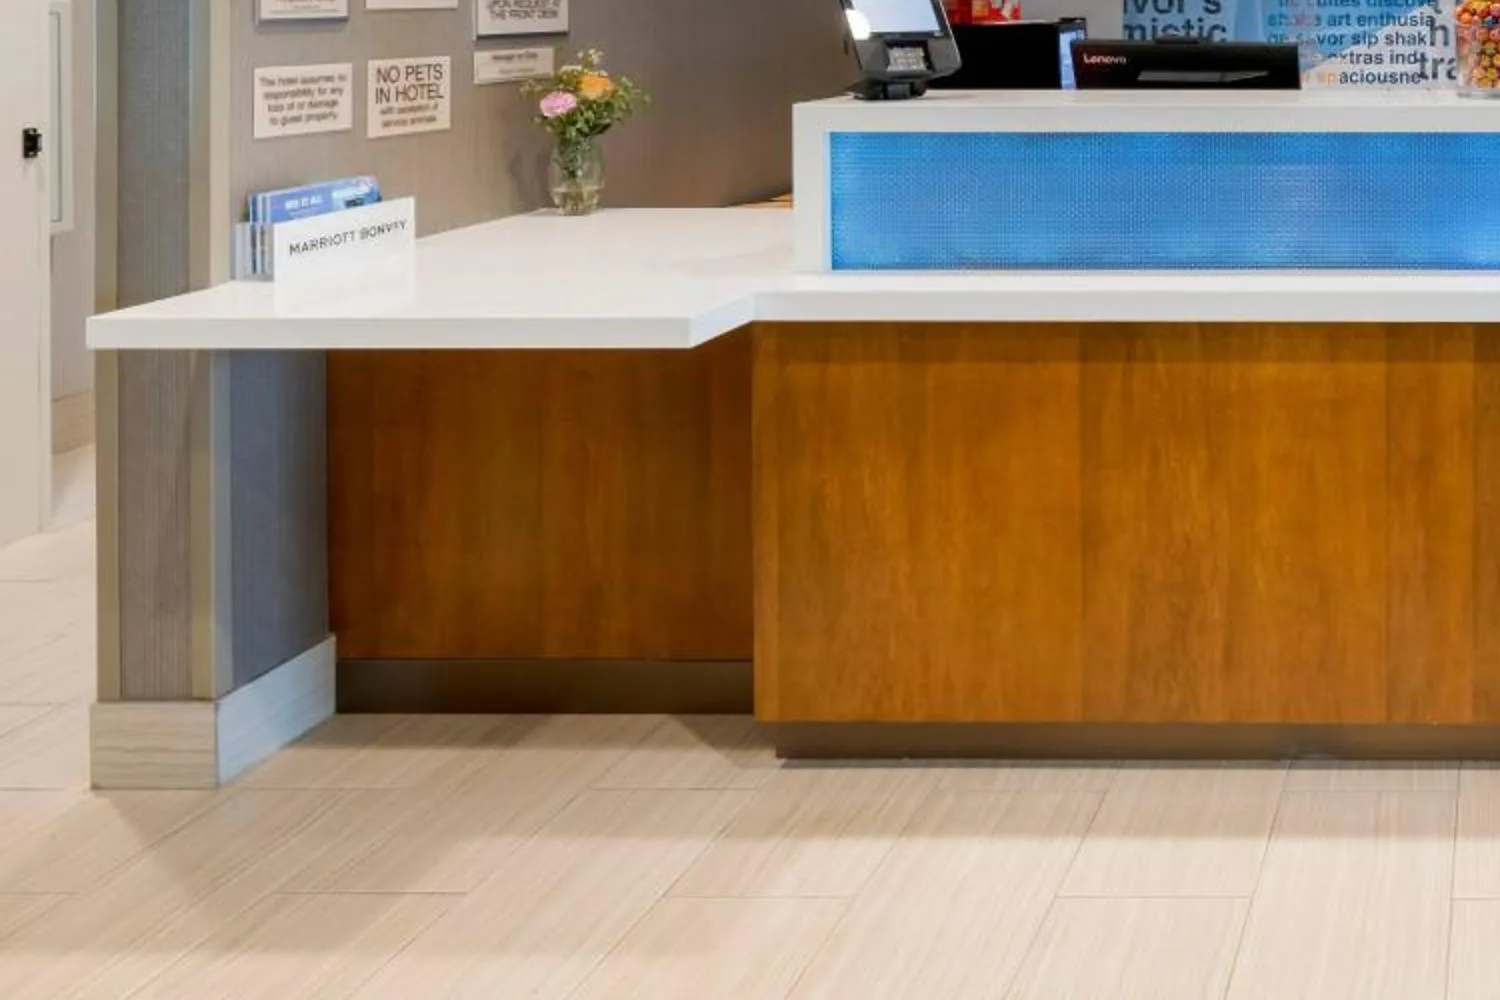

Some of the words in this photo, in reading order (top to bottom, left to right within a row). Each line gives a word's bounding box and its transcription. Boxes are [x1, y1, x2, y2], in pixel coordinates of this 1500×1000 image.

[1083, 54, 1127, 64] Lenovo
[376, 65, 400, 84] NO
[405, 63, 443, 82] PETS
[375, 85, 391, 104] IN
[395, 83, 444, 102] HOTEL
[289, 231, 355, 256] MARRIOTT
